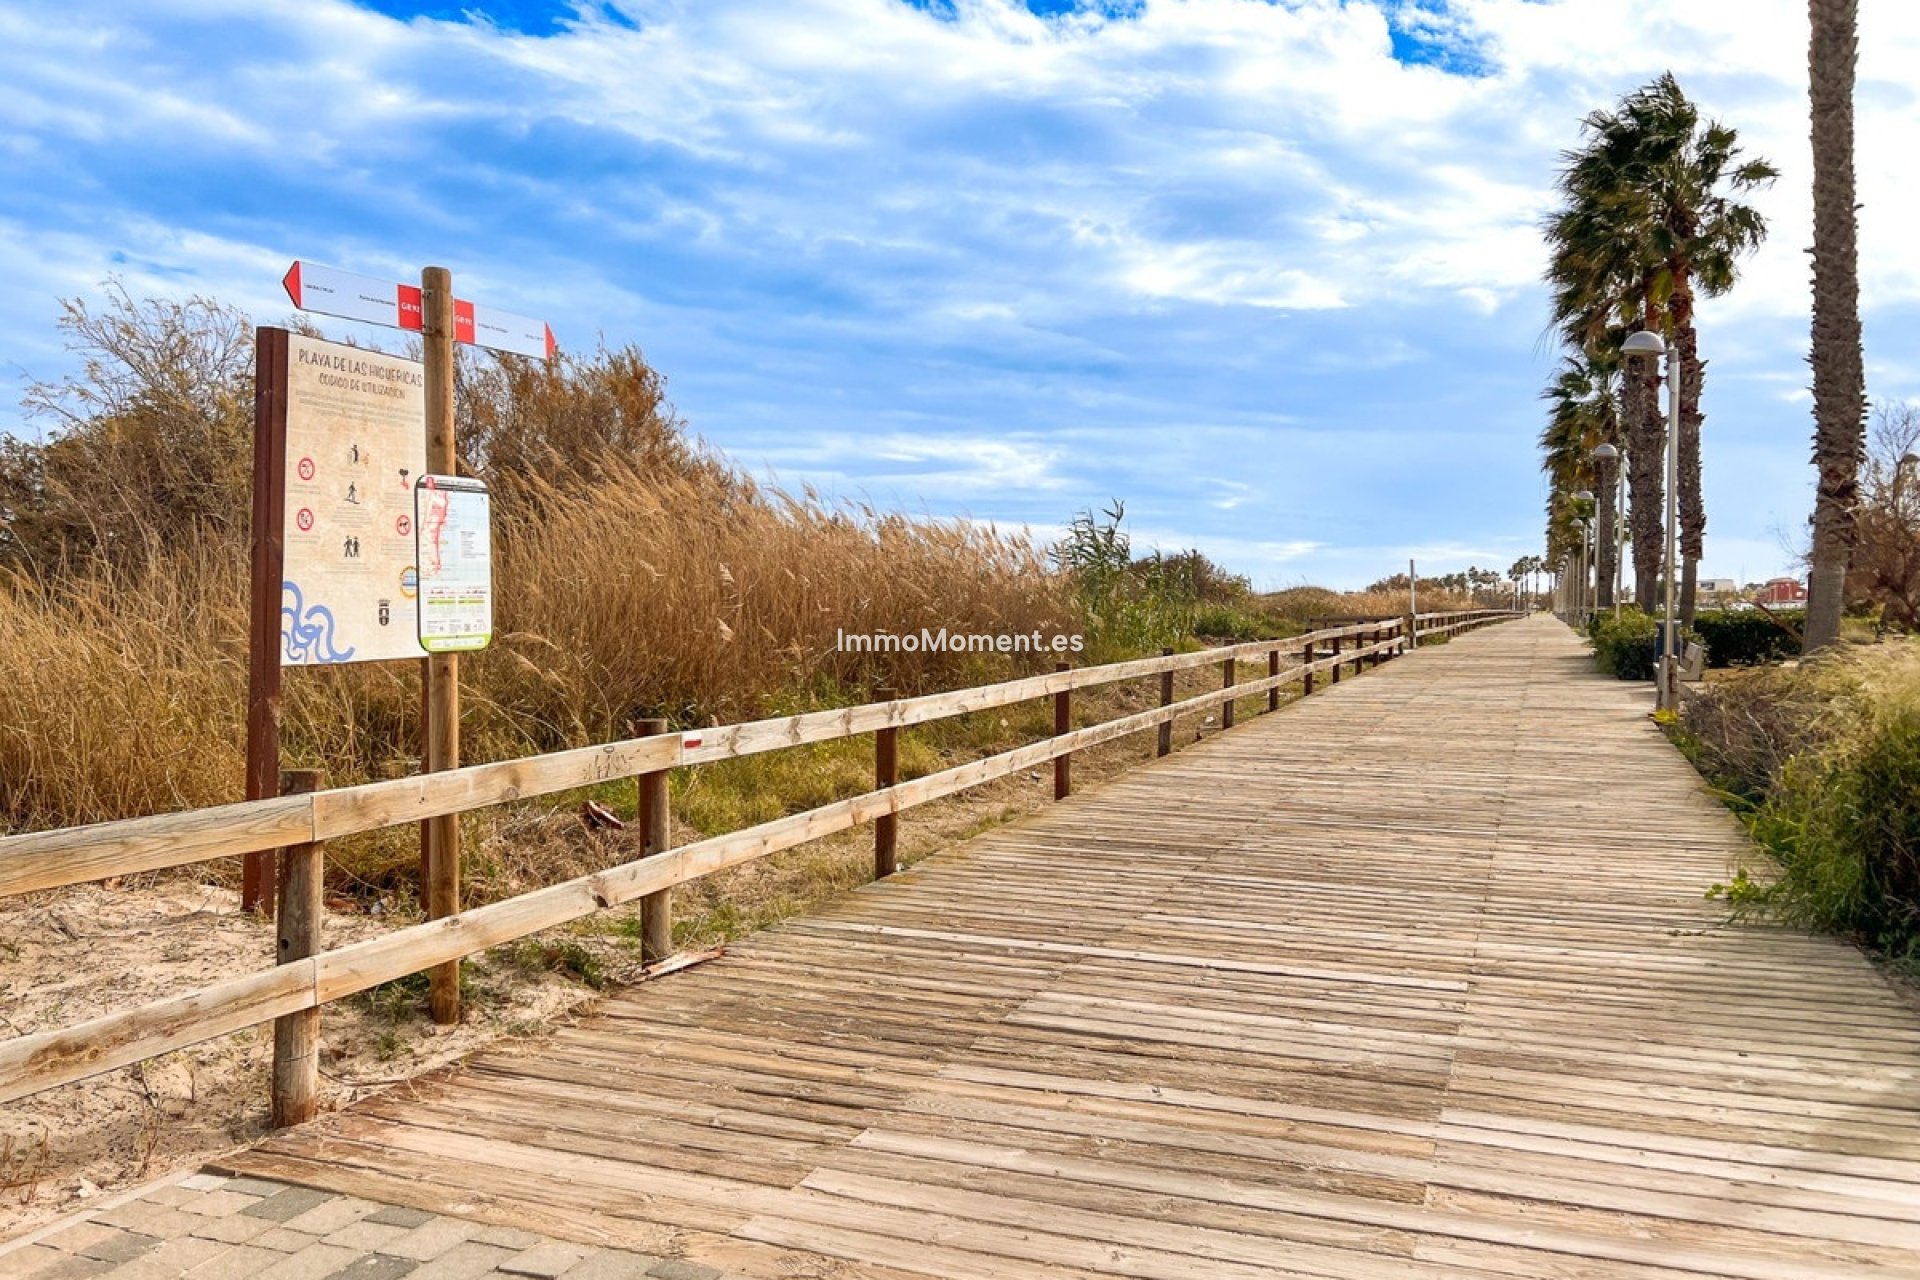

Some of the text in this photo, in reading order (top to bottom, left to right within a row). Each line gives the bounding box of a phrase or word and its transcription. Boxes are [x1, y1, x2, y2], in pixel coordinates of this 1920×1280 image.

[298, 348, 423, 388] PLAYA DE LAS HIGUERICAS
[350, 378, 361, 391] DE
